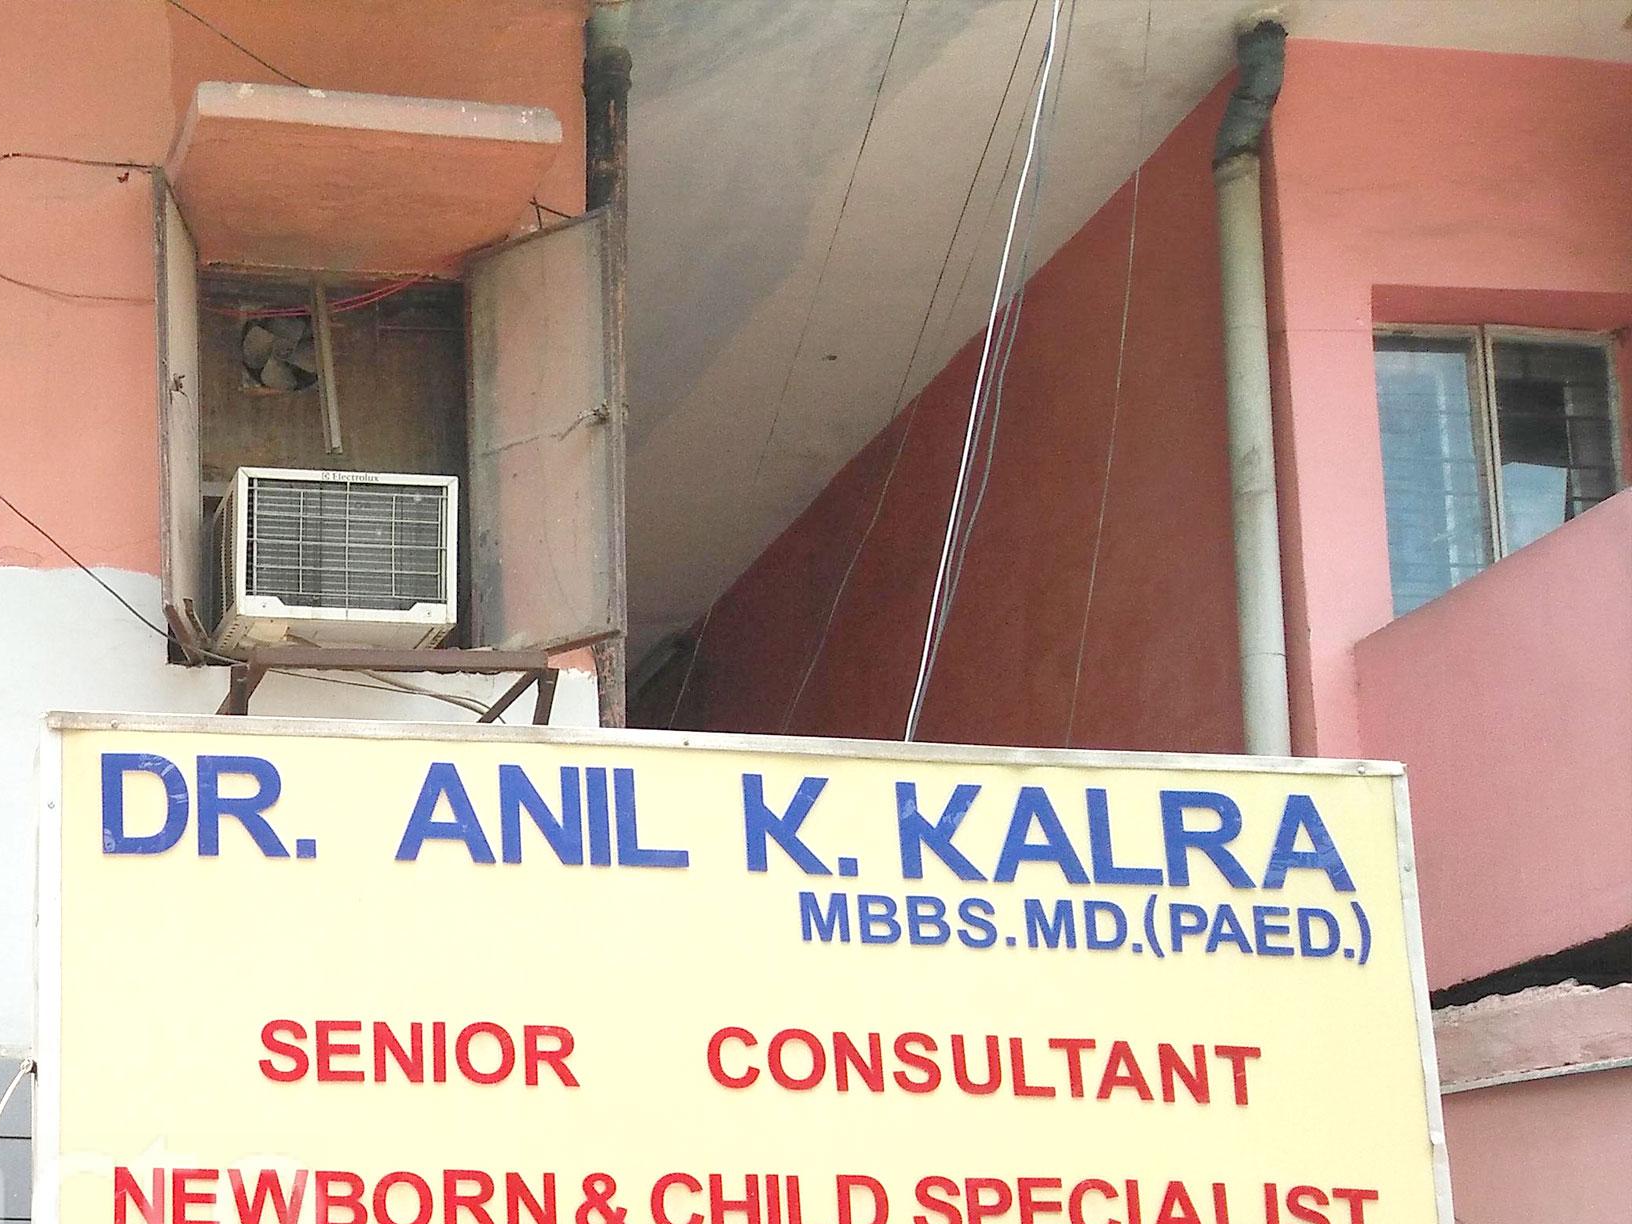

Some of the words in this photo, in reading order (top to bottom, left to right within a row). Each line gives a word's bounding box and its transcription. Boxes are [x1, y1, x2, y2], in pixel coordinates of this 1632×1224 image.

[331, 471, 380, 482] Electrolux
[101, 752, 318, 859] DR.
[395, 761, 690, 869] ANIL
[741, 772, 860, 878] K.
[894, 780, 1356, 893] KALRA
[258, 1019, 580, 1089] SENIOR
[707, 1026, 1262, 1107] CONSULTANT
